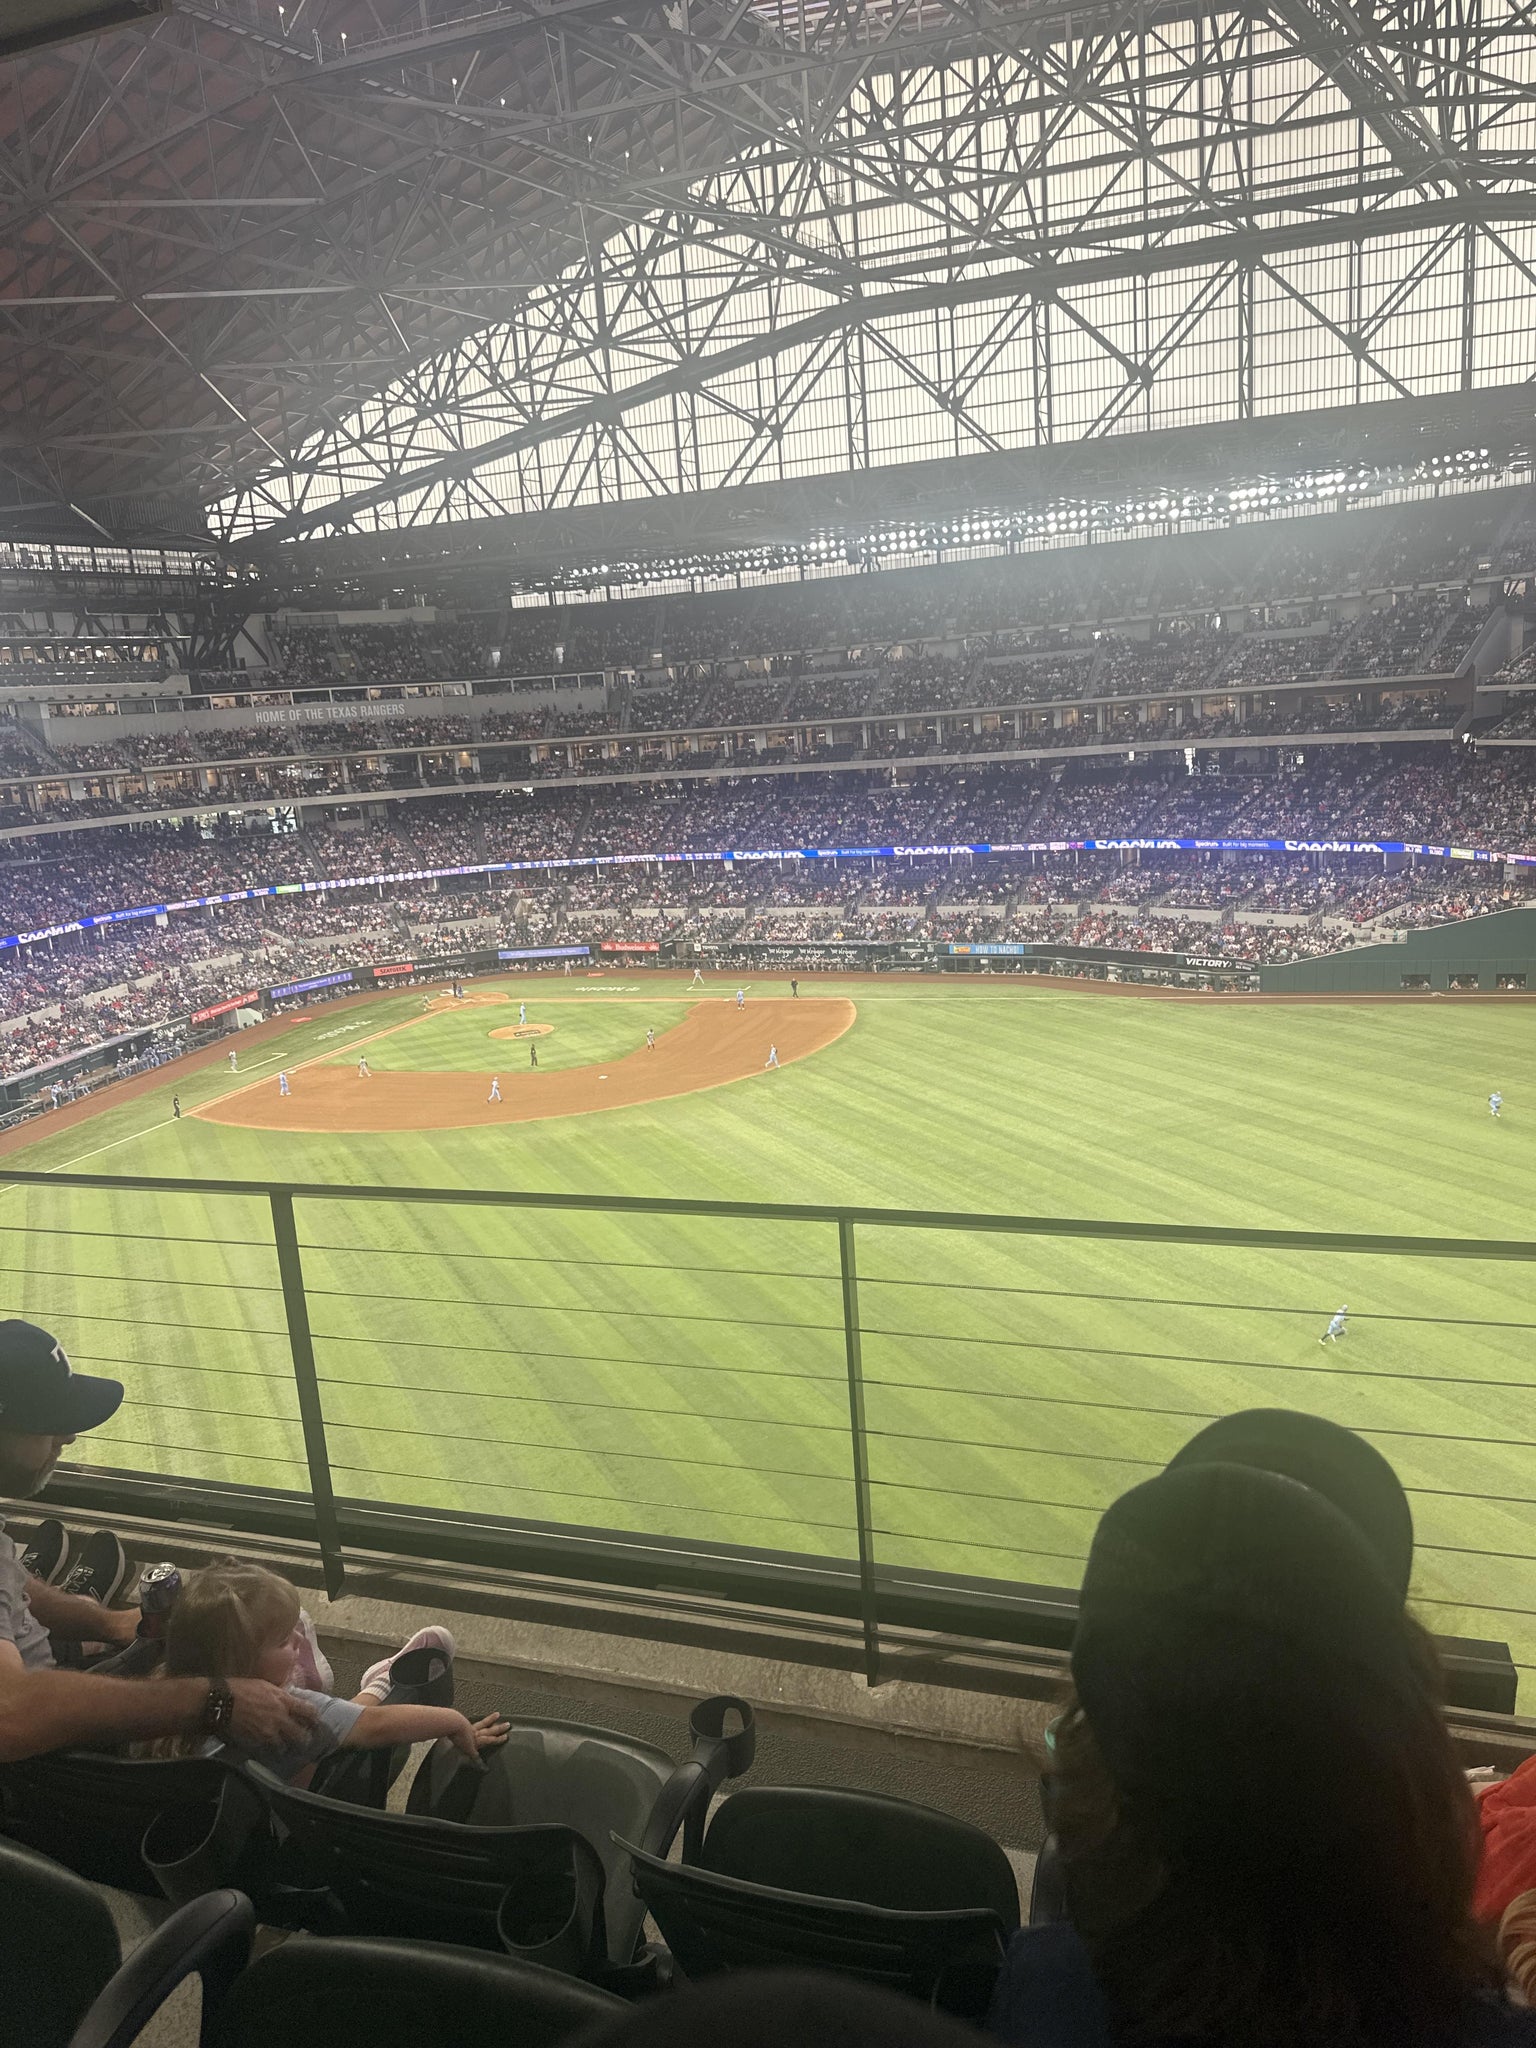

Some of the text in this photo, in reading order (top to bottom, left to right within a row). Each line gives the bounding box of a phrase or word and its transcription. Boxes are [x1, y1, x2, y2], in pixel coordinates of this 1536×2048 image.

[255, 703, 405, 723] HOME OF THE TEXAS RANGERS
[1095, 839, 1181, 849] Spectrum
[1285, 841, 1383, 852] Spectrum
[733, 851, 806, 859] Spectrum
[893, 845, 974, 855] Spectrum
[615, 942, 646, 951] Budweiser
[975, 945, 988, 954] HOW
[991, 945, 997, 954] TO
[776, 947, 794, 957] Kroger
[807, 947, 825, 957] Kroger
[838, 947, 857, 957] Kroger
[1185, 957, 1229, 968] VICTORY
